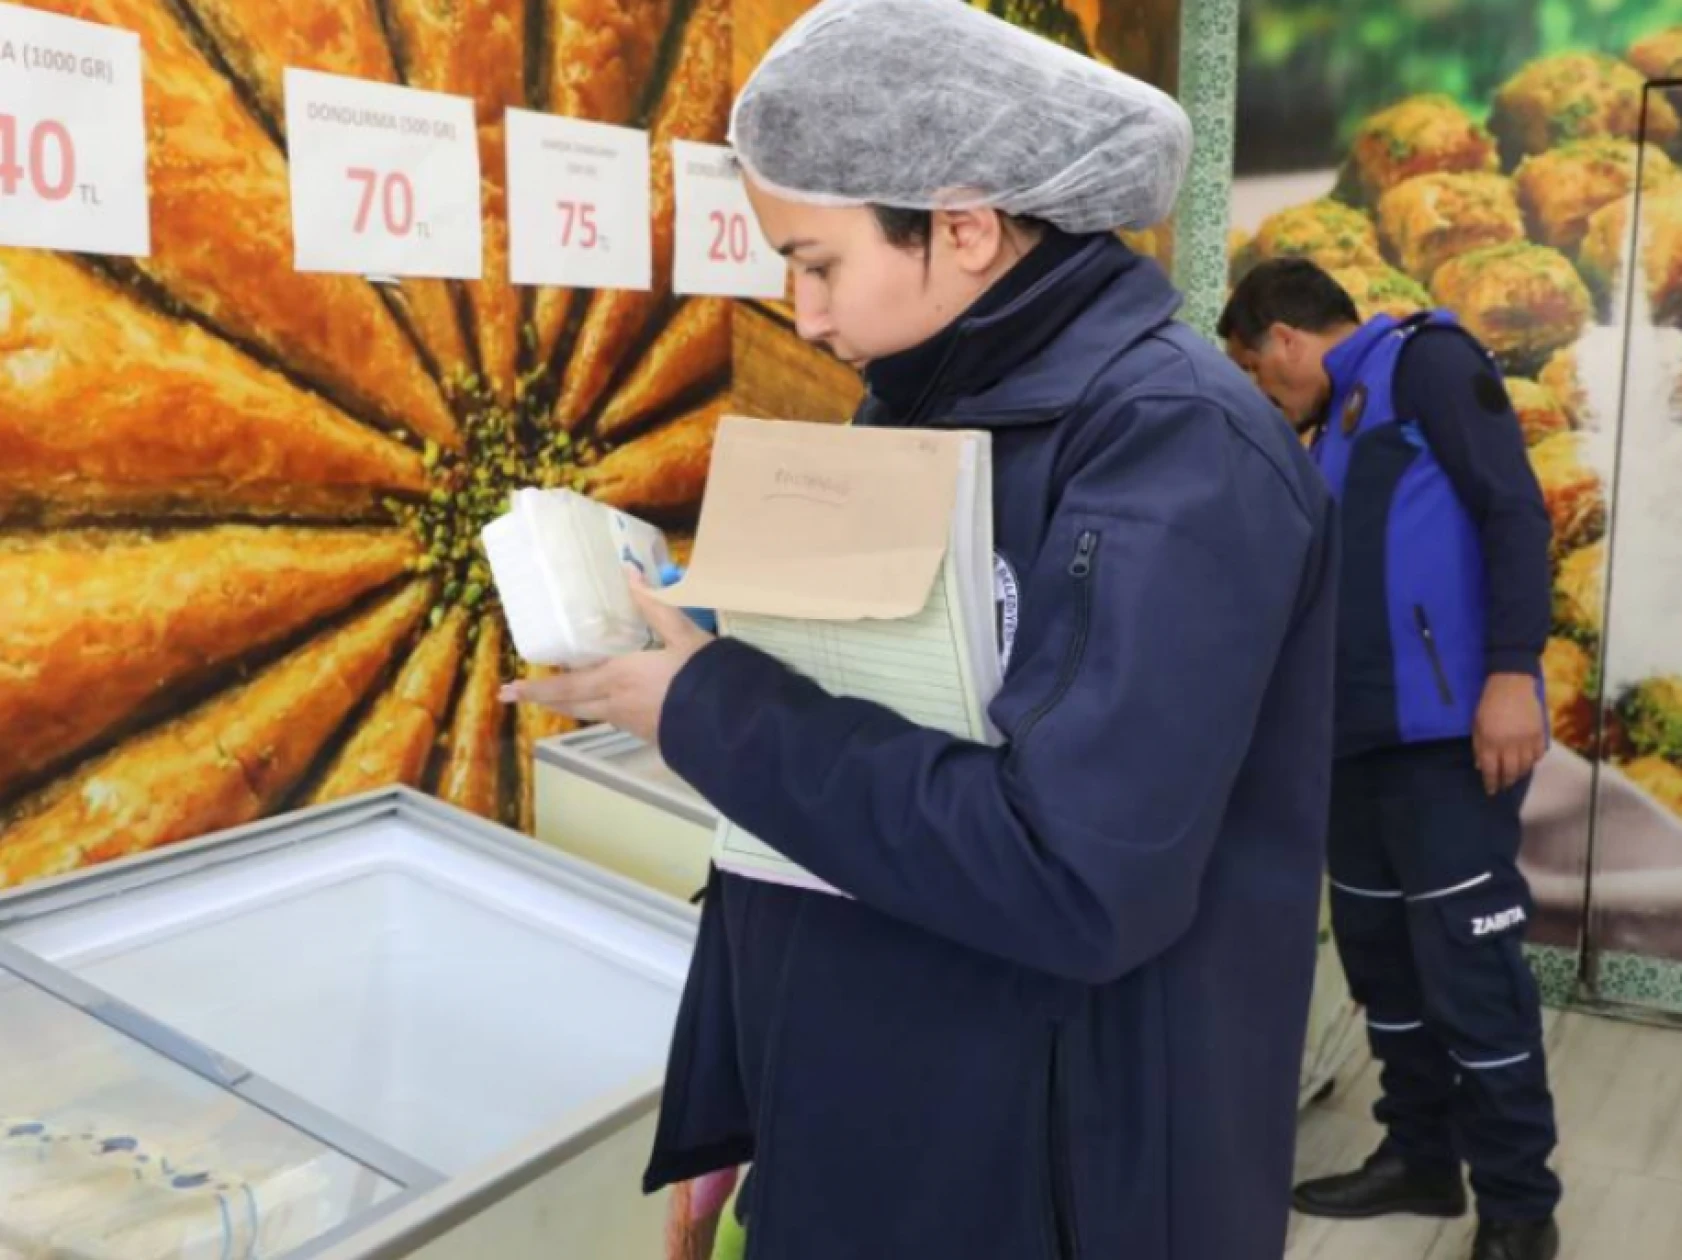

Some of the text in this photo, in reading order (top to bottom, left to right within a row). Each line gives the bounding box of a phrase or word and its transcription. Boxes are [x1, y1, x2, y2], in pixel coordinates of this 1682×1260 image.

[346, 167, 415, 238] 70
[556, 201, 598, 248] 75
[708, 210, 749, 263] 20
